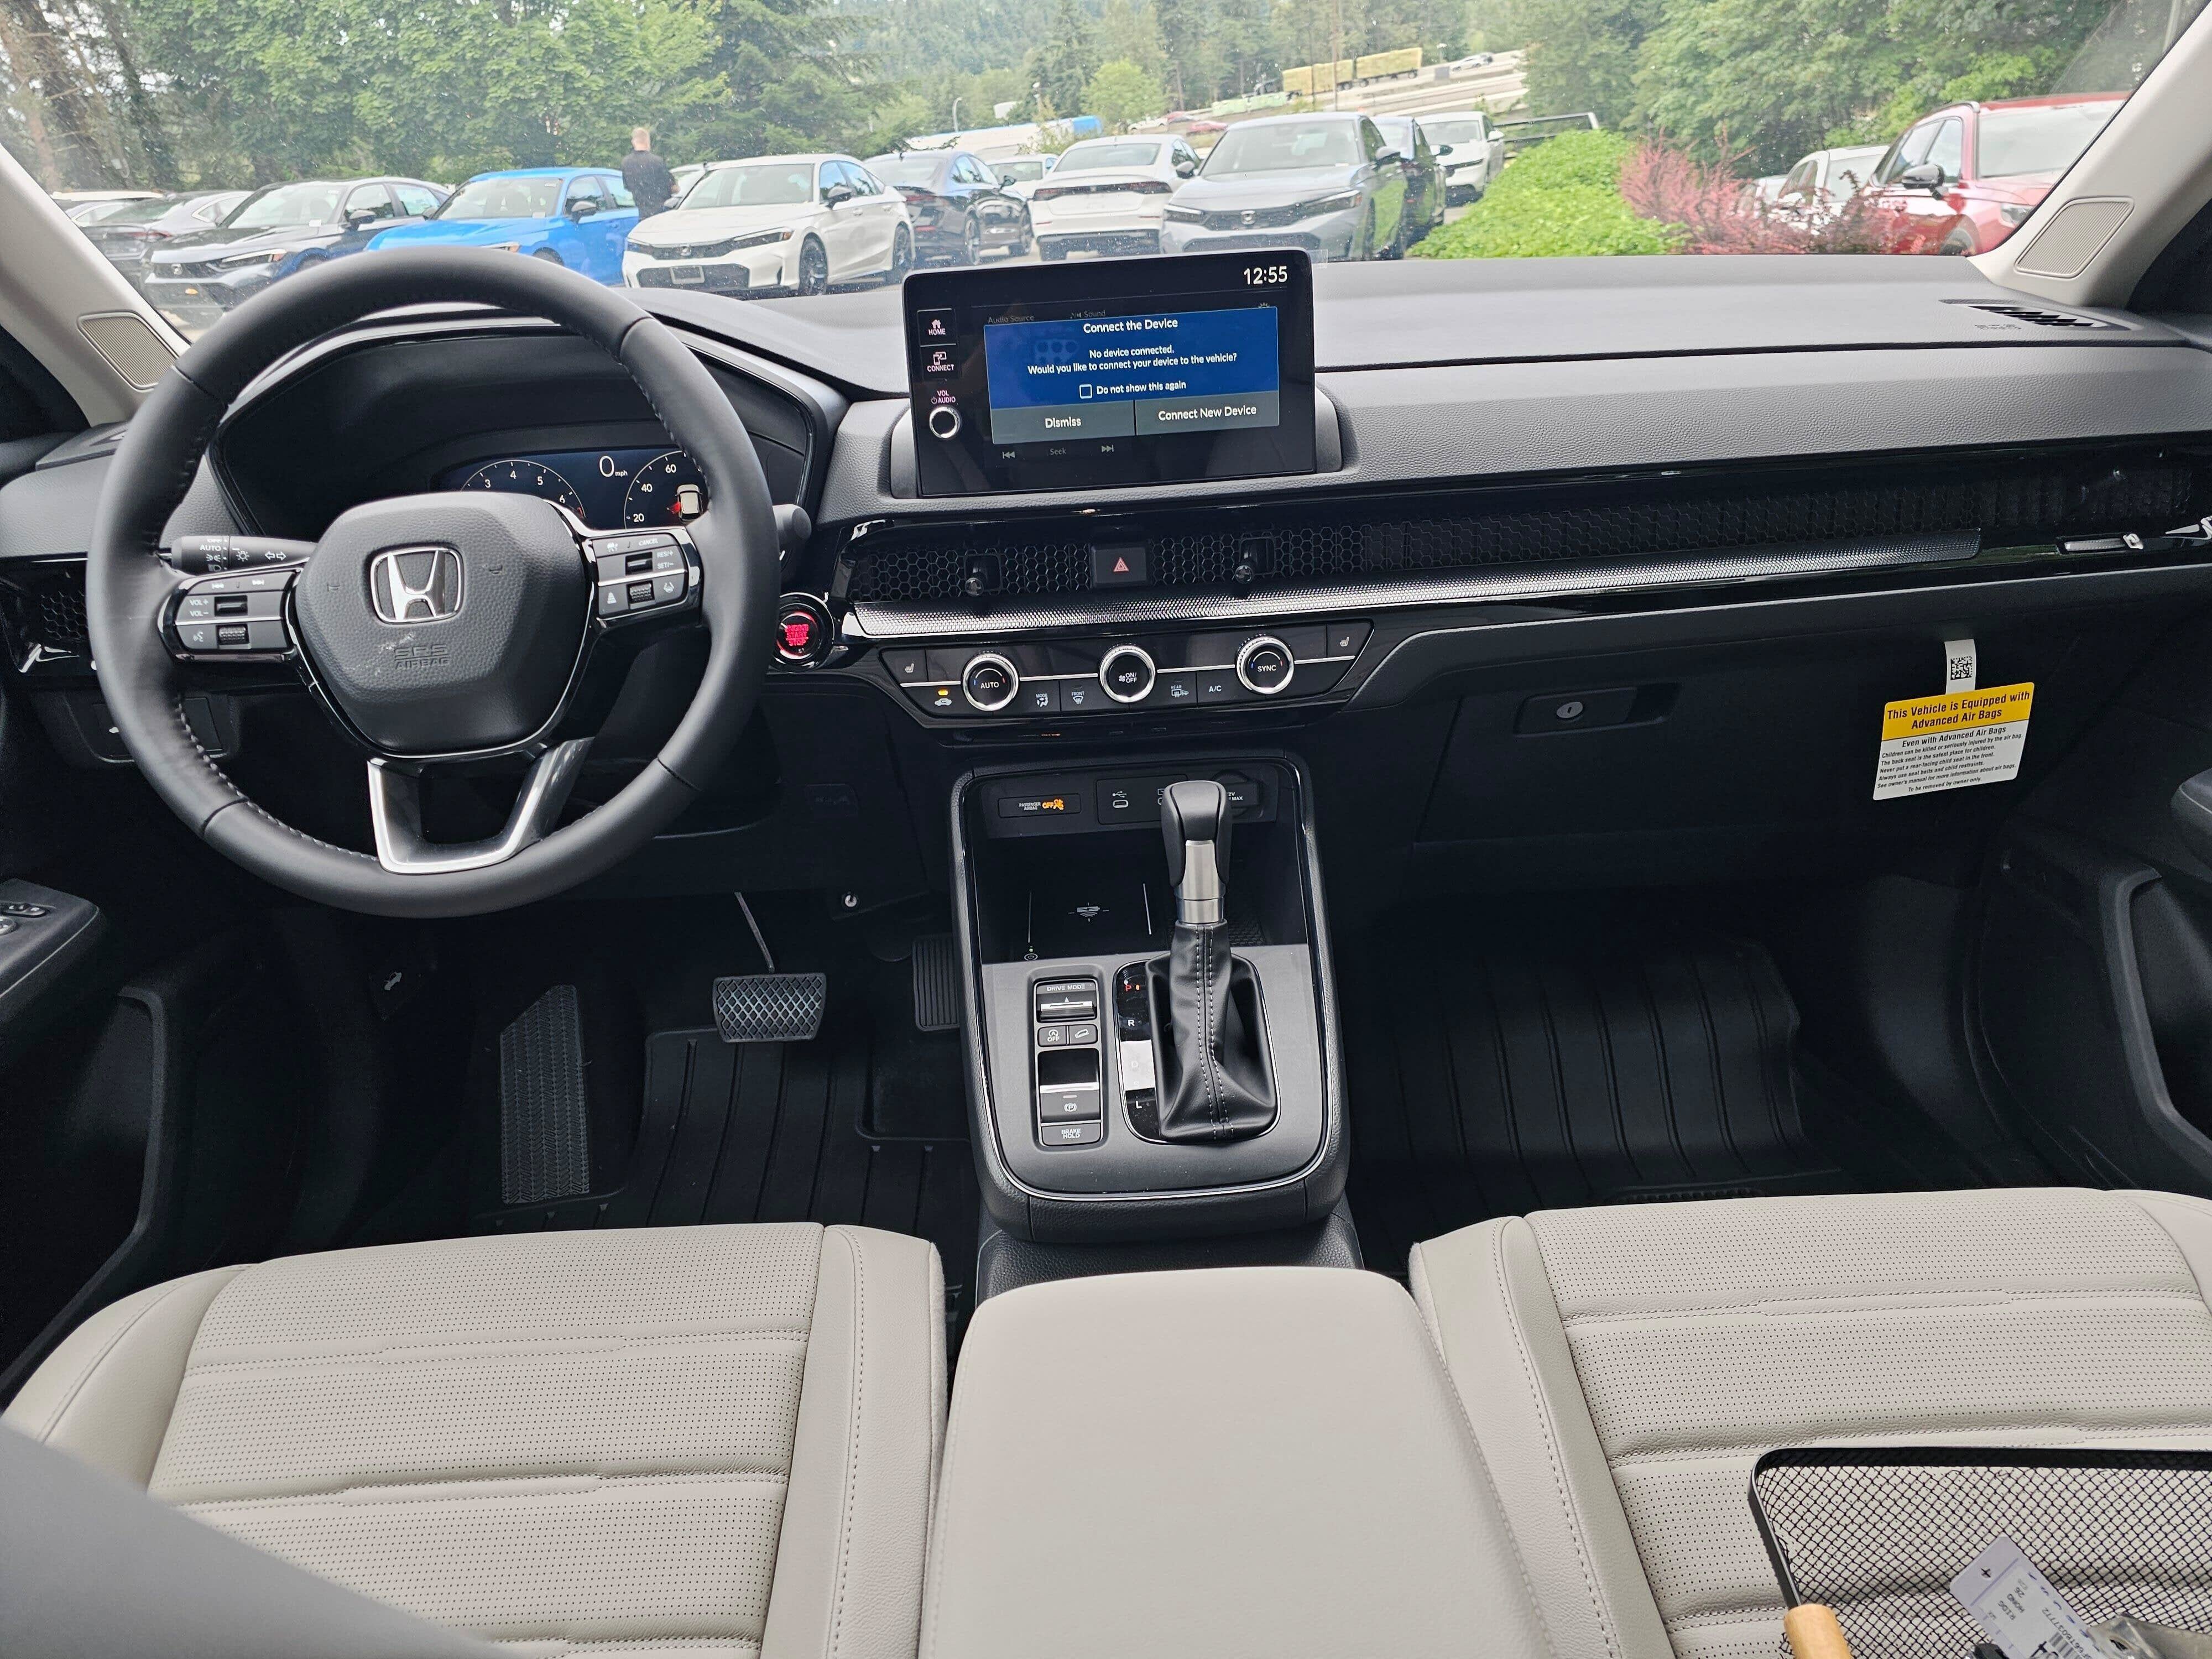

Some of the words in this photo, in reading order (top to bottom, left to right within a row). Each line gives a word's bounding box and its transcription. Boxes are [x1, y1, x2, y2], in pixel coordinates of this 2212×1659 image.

[1244, 265, 1287, 285] 12:55
[1083, 322, 1124, 333] Connect
[1126, 320, 1142, 331] the
[1144, 318, 1178, 330] Device
[1089, 349, 1102, 358] No
[1104, 347, 1129, 357] device
[1131, 345, 1175, 356] connected.
[1027, 364, 1055, 374] Would
[1056, 364, 1072, 374] you
[1073, 362, 1087, 372] like
[1089, 362, 1097, 371] to
[1099, 360, 1131, 370] connect
[1133, 359, 1151, 369] your
[1153, 356, 1178, 366] device
[1191, 355, 1204, 364] the
[1206, 352, 1237, 363] vehicle?
[1097, 385, 1109, 395] Do
[1125, 383, 1146, 393] show
[1149, 382, 1164, 390] this
[1165, 380, 1186, 391] again
[1158, 409, 1198, 421] Connect
[1200, 407, 1222, 418] New
[1224, 405, 1256, 417] Device
[1045, 416, 1082, 429] Dismiss
[1050, 447, 1067, 456] Seek
[599, 456, 614, 477] 0
[665, 464, 676, 473] 60
[510, 471, 517, 479] 4
[484, 479, 491, 488] 3
[538, 476, 543, 485] 5
[641, 483, 653, 492] 40
[560, 495, 565, 503] 6
[633, 513, 644, 522] 20
[1888, 709, 1907, 719] This
[1911, 703, 1946, 716] Vehicle
[1950, 702, 1958, 711] is
[1961, 694, 2006, 709] Equipped
[2010, 692, 2030, 702] with
[1911, 716, 1958, 729] Advanced
[1961, 713, 1975, 722] Air
[1979, 709, 2002, 721] Bags
[1922, 736, 1937, 744] with
[1939, 731, 1974, 742] Advanced
[1989, 727, 2006, 735] Bags
[1944, 741, 1966, 749] seriously
[1910, 761, 1938, 769] rear-facing
[1950, 768, 1979, 778] information
[1135, 1100, 1142, 1109] L
